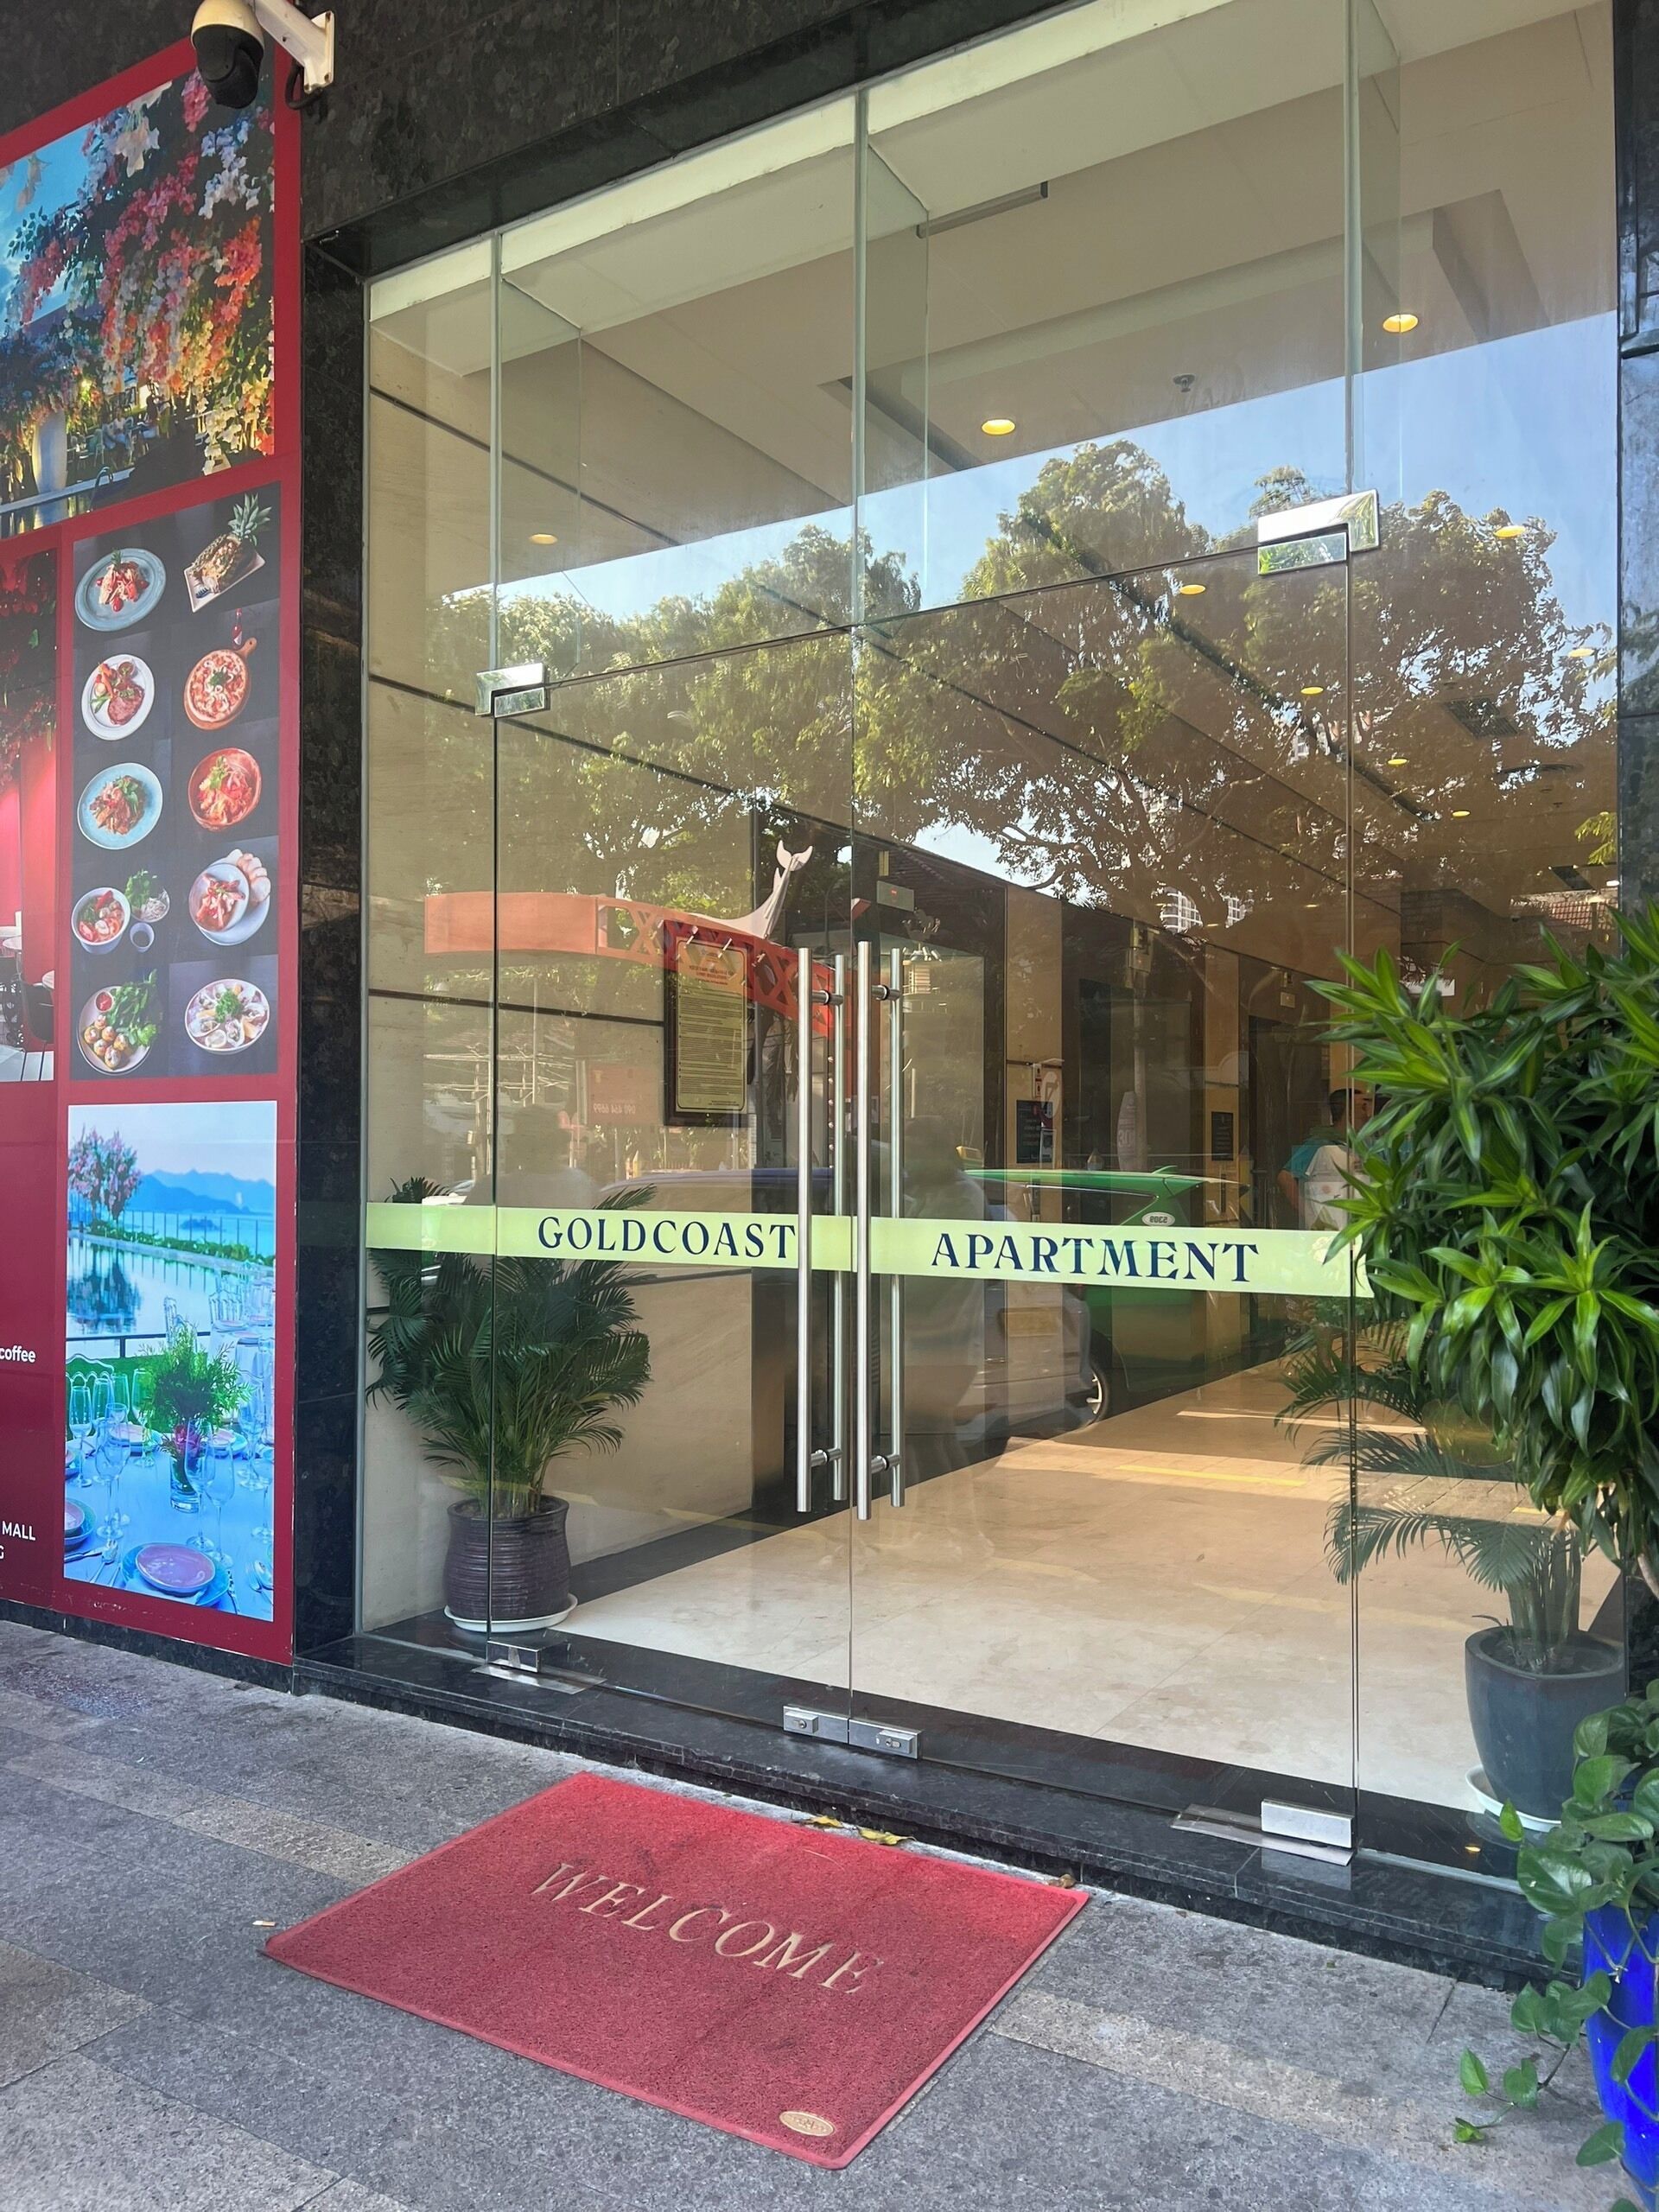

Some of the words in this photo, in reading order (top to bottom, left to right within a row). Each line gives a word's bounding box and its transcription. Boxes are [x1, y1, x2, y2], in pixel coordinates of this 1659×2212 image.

[537, 1216, 796, 1259] GOLDCOAST
[931, 1232, 1260, 1282] APARTMENT
[0, 1344, 36, 1363] coffee
[2, 1520, 36, 1541] MALL
[530, 1861, 886, 1994] WELCOME
